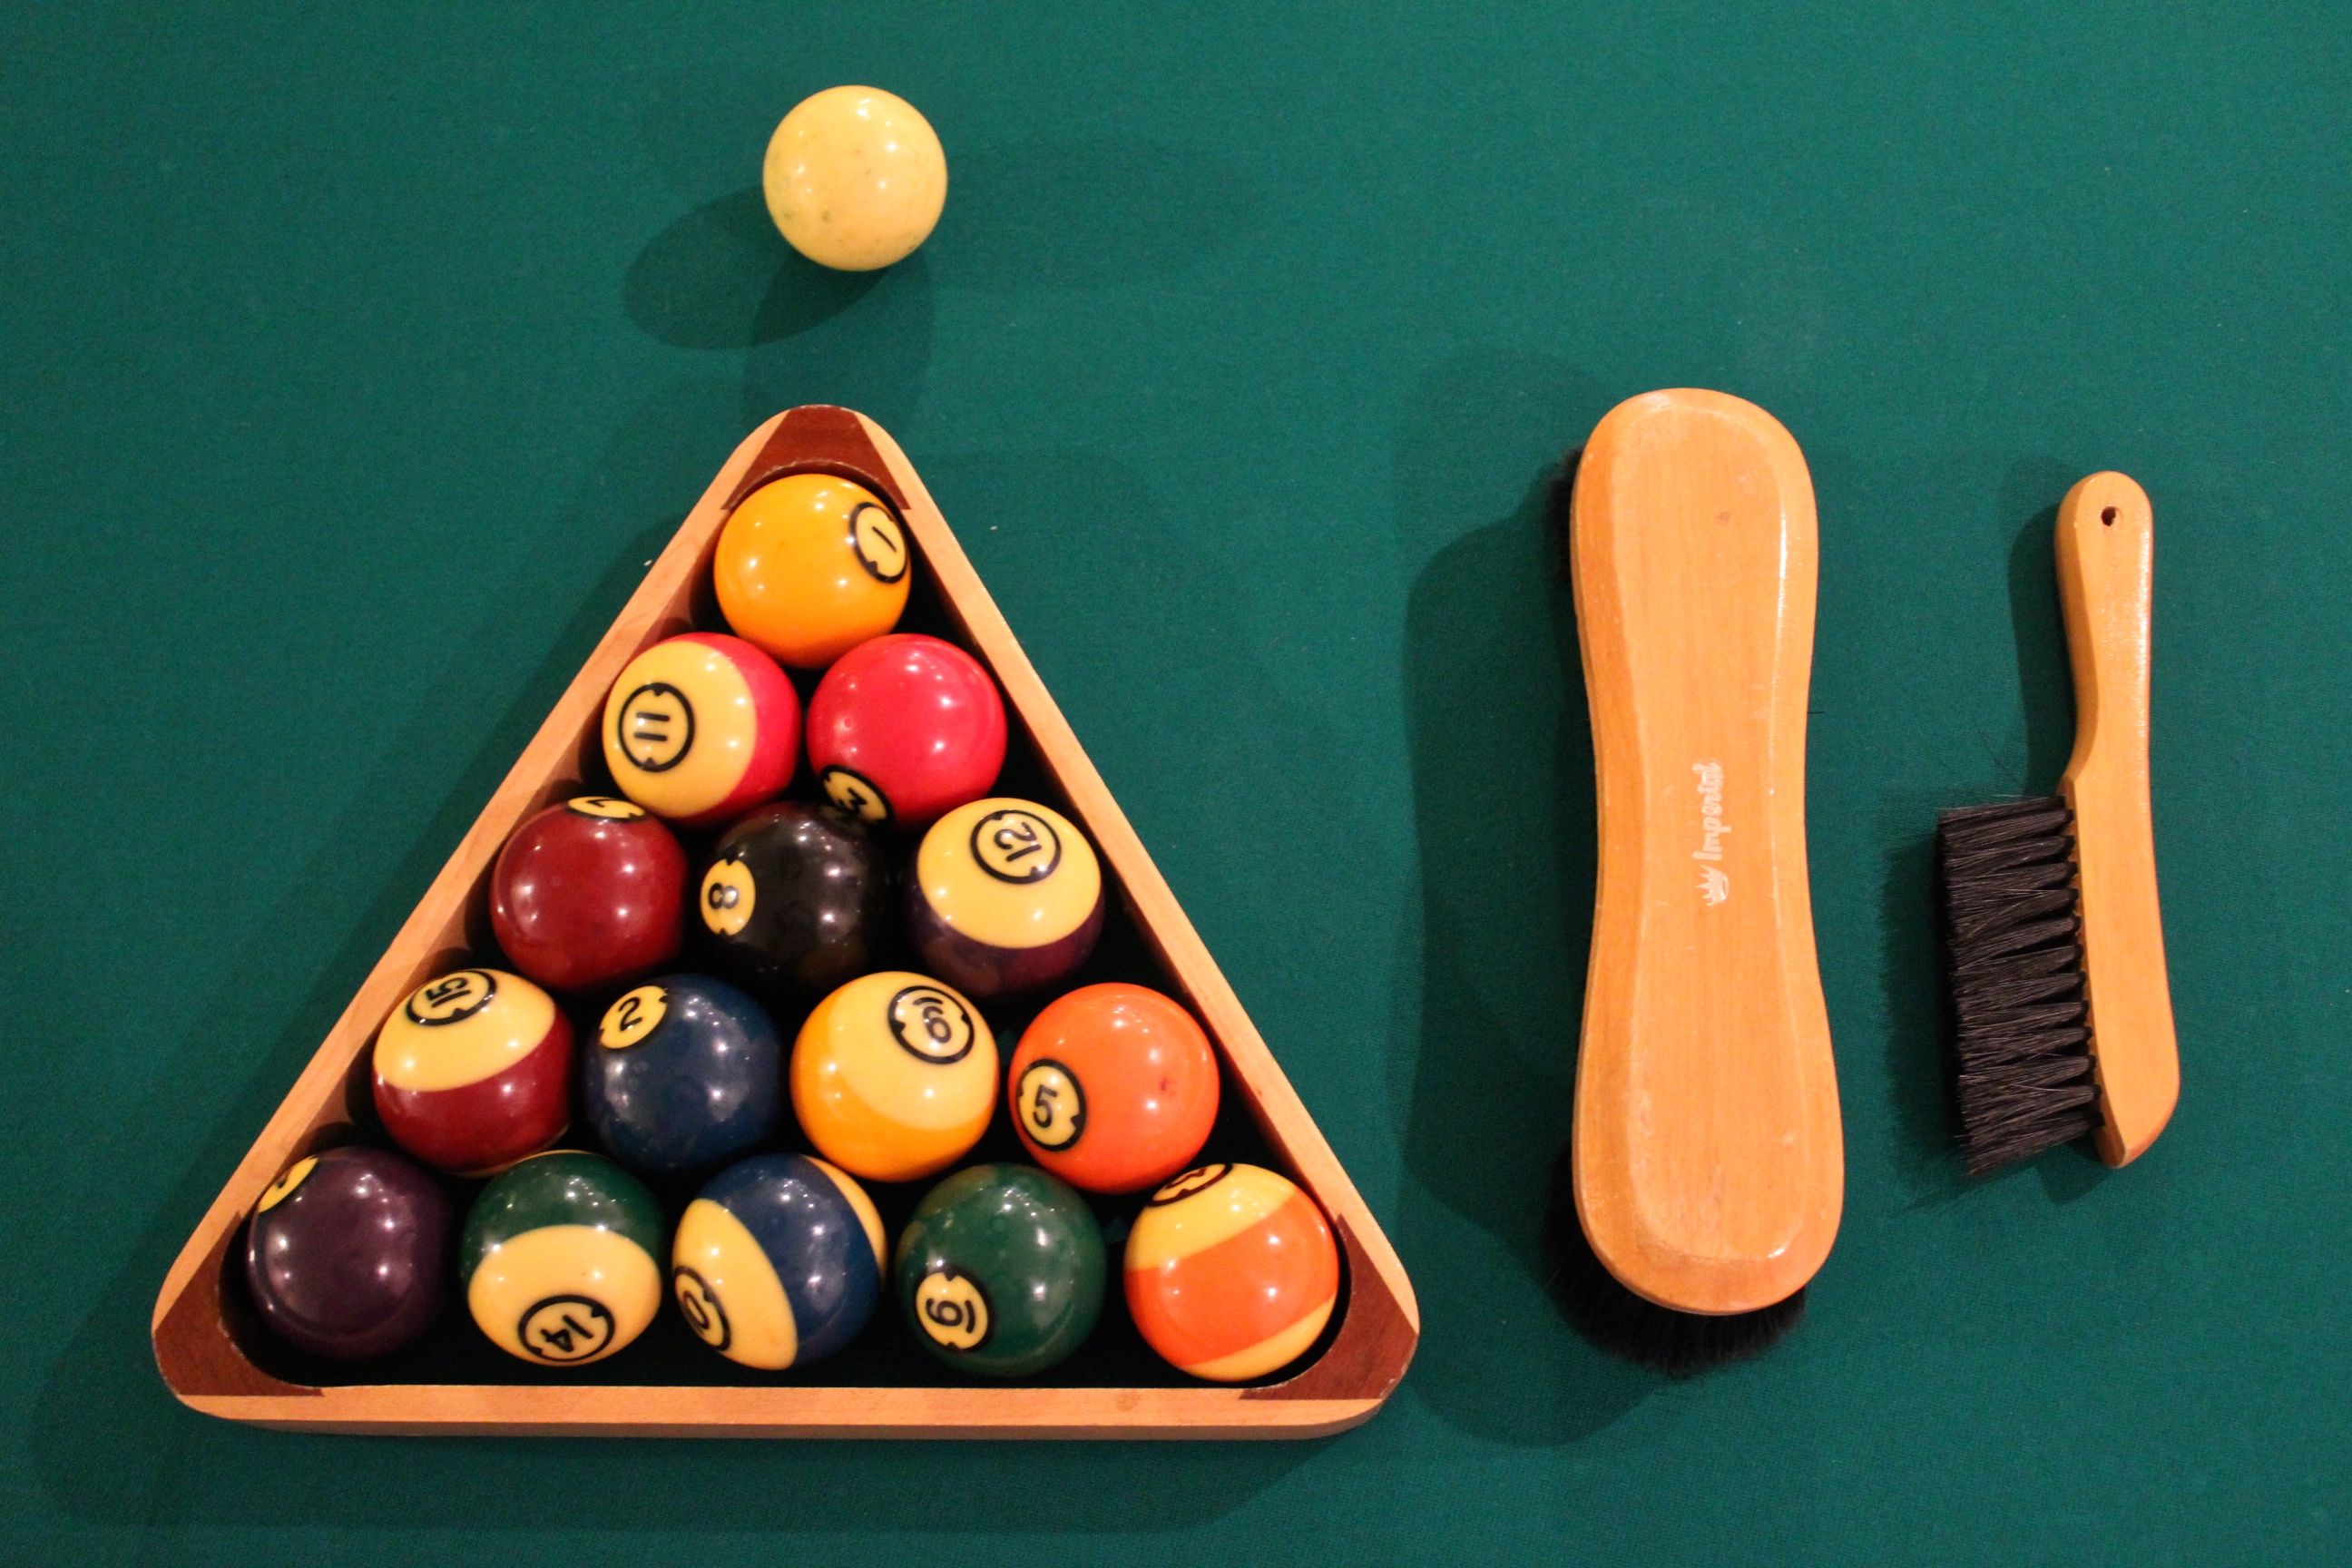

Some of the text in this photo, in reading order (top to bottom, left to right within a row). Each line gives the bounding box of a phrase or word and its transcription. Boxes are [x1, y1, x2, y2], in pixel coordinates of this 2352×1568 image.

[871, 525, 897, 554] 1
[632, 710, 671, 742] 11
[994, 820, 1043, 863] 12
[708, 881, 740, 909] 8
[424, 976, 472, 1010] 15
[617, 995, 642, 1033] 2
[1031, 1083, 1059, 1129] 5
[540, 1312, 595, 1352] 14
